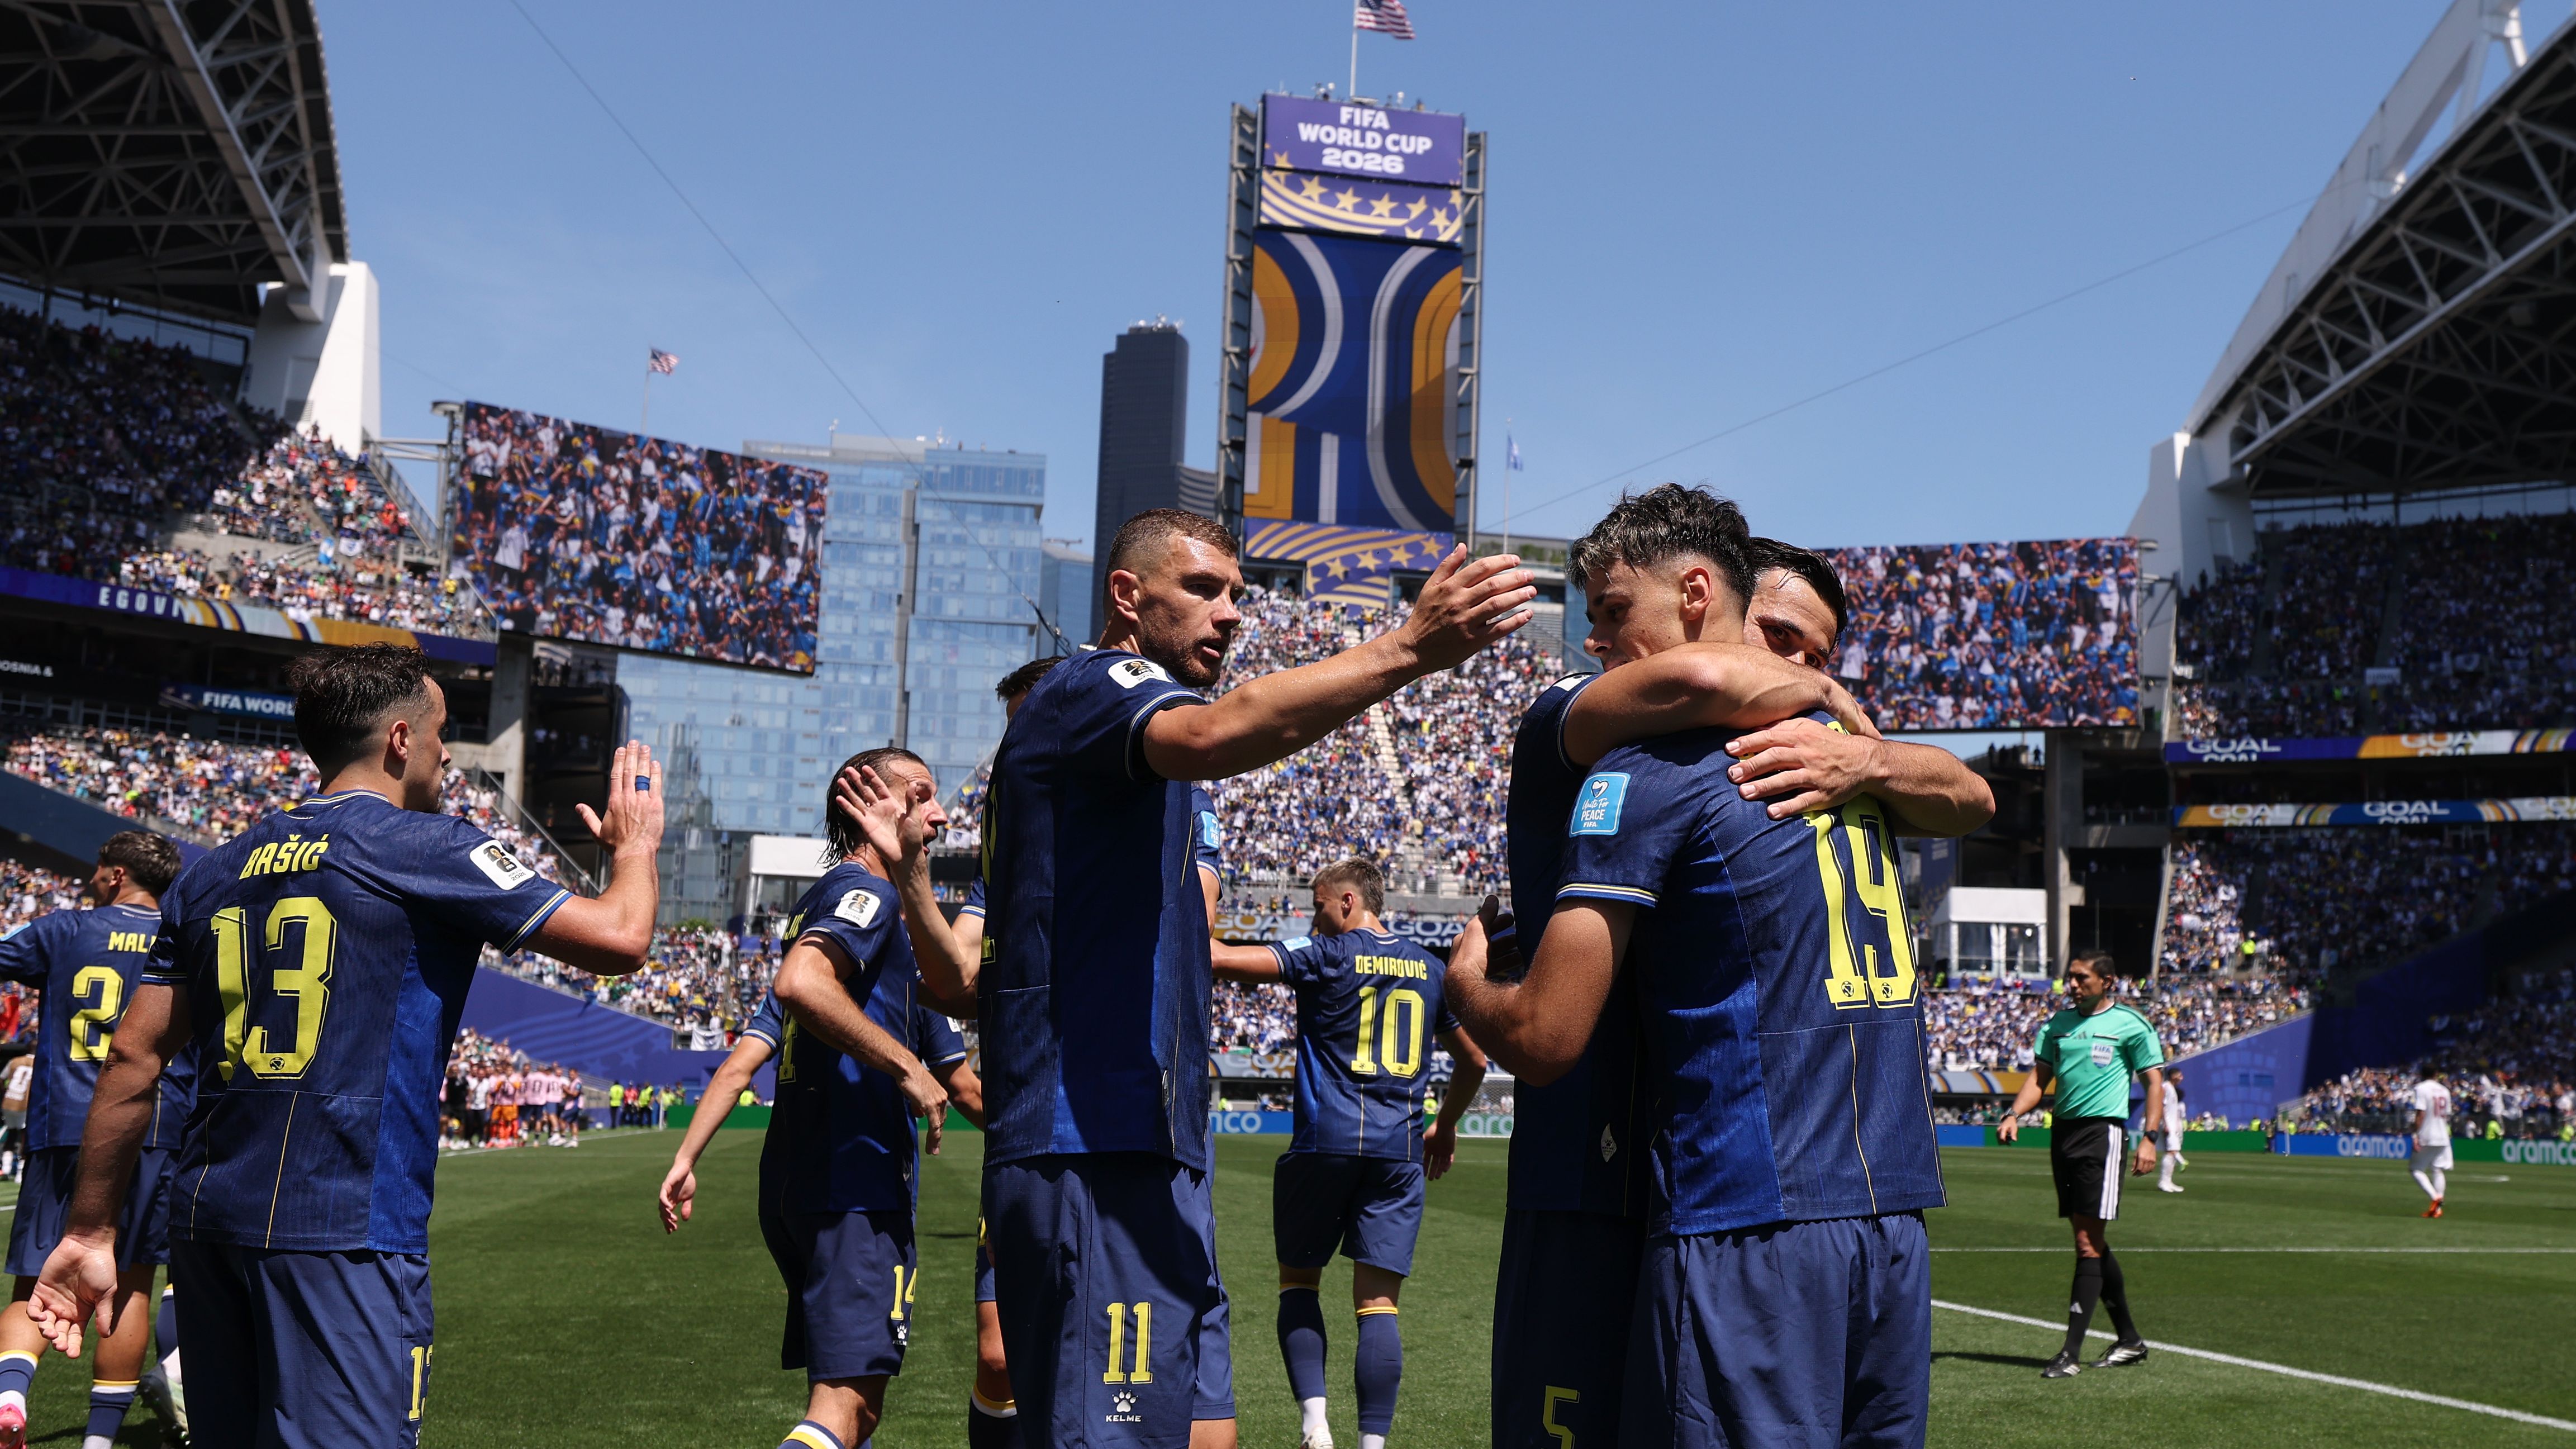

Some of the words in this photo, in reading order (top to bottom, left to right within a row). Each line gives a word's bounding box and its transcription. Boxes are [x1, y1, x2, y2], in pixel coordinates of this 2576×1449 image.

[1340, 106, 1390, 130] FIFA
[1297, 122, 1382, 150] WORLD
[1385, 134, 1433, 155] CUP
[1322, 147, 1405, 174] 2026
[0, 660, 41, 676] OSNIA
[203, 691, 242, 710] FIFA
[244, 696, 296, 717] WORL
[1581, 810, 1605, 821] PEACE
[1582, 799, 1598, 810] Unite
[1599, 798, 1609, 809] For
[2363, 801, 2450, 816] GOAL
[239, 834, 329, 880] BAŠIĆ
[1803, 792, 1918, 1010] 19
[1388, 921, 1465, 937] GOA
[1355, 955, 1427, 981] DEMIROVIĆ
[211, 897, 337, 1084] 13
[70, 966, 127, 1061] 2
[1351, 986, 1425, 1079] 10
[2337, 1135, 2406, 1158] aramco
[891, 1265, 917, 1320] 14
[1103, 1302, 1153, 1385] 11
[1543, 1385, 1580, 1449] 5
